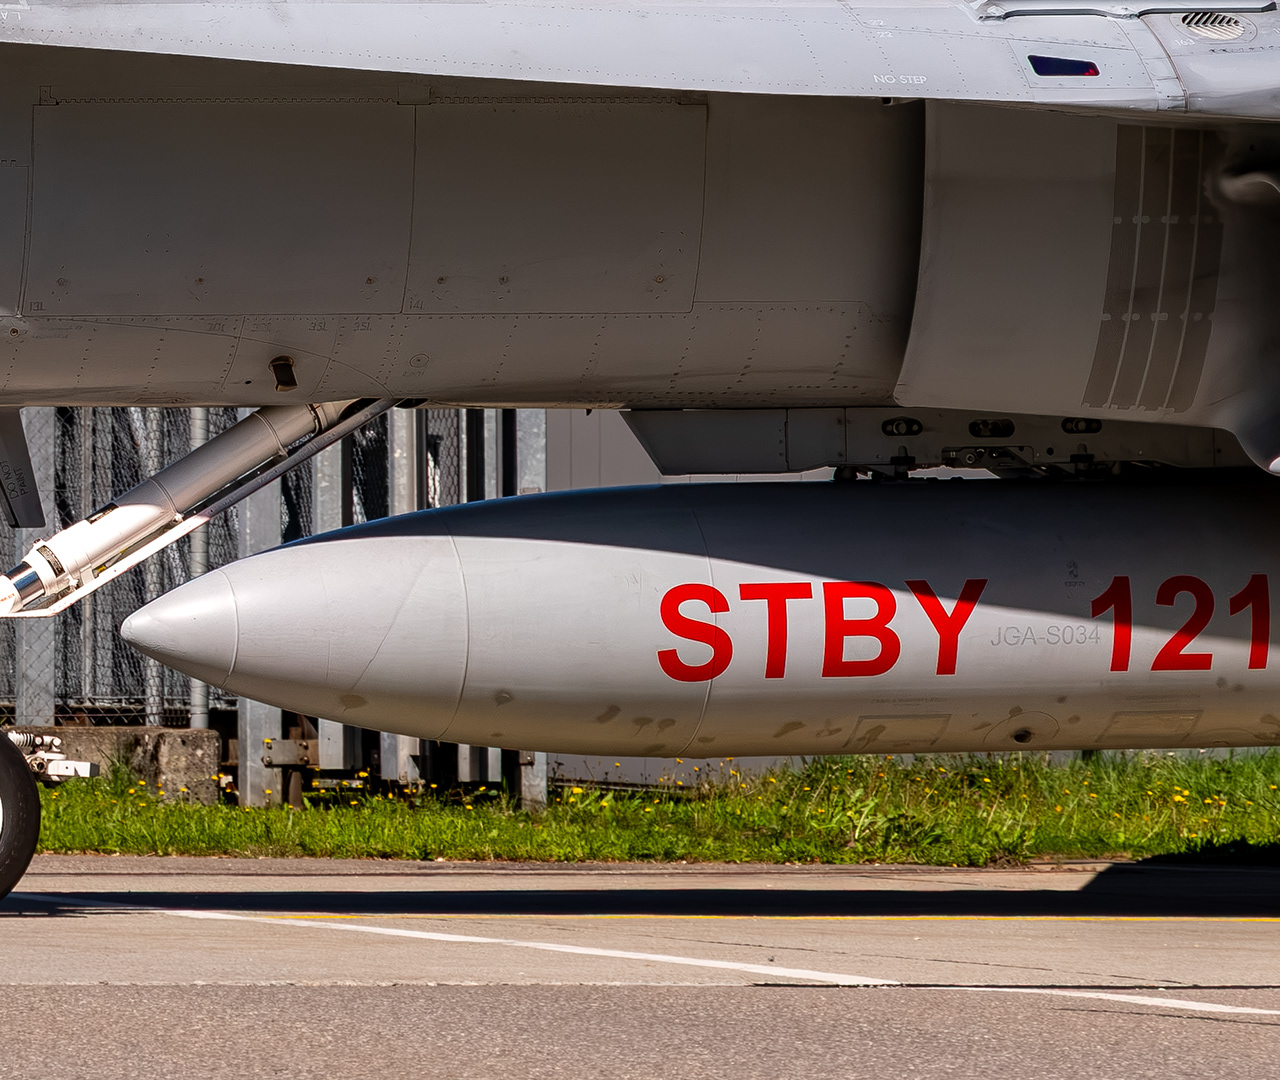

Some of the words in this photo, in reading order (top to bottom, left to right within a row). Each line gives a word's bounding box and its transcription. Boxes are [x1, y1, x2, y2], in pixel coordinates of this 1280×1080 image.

[1174, 39, 1196, 47] 163
[873, 74, 896, 84] NO
[900, 74, 928, 84] STEP
[29, 301, 46, 312] 13L
[0, 459, 14, 481] NOT
[7, 482, 20, 500] DO
[13, 467, 30, 496] PAINT
[657, 577, 989, 683] STBY
[1090, 573, 1271, 673] 121
[990, 624, 1101, 647] JGA-S034
